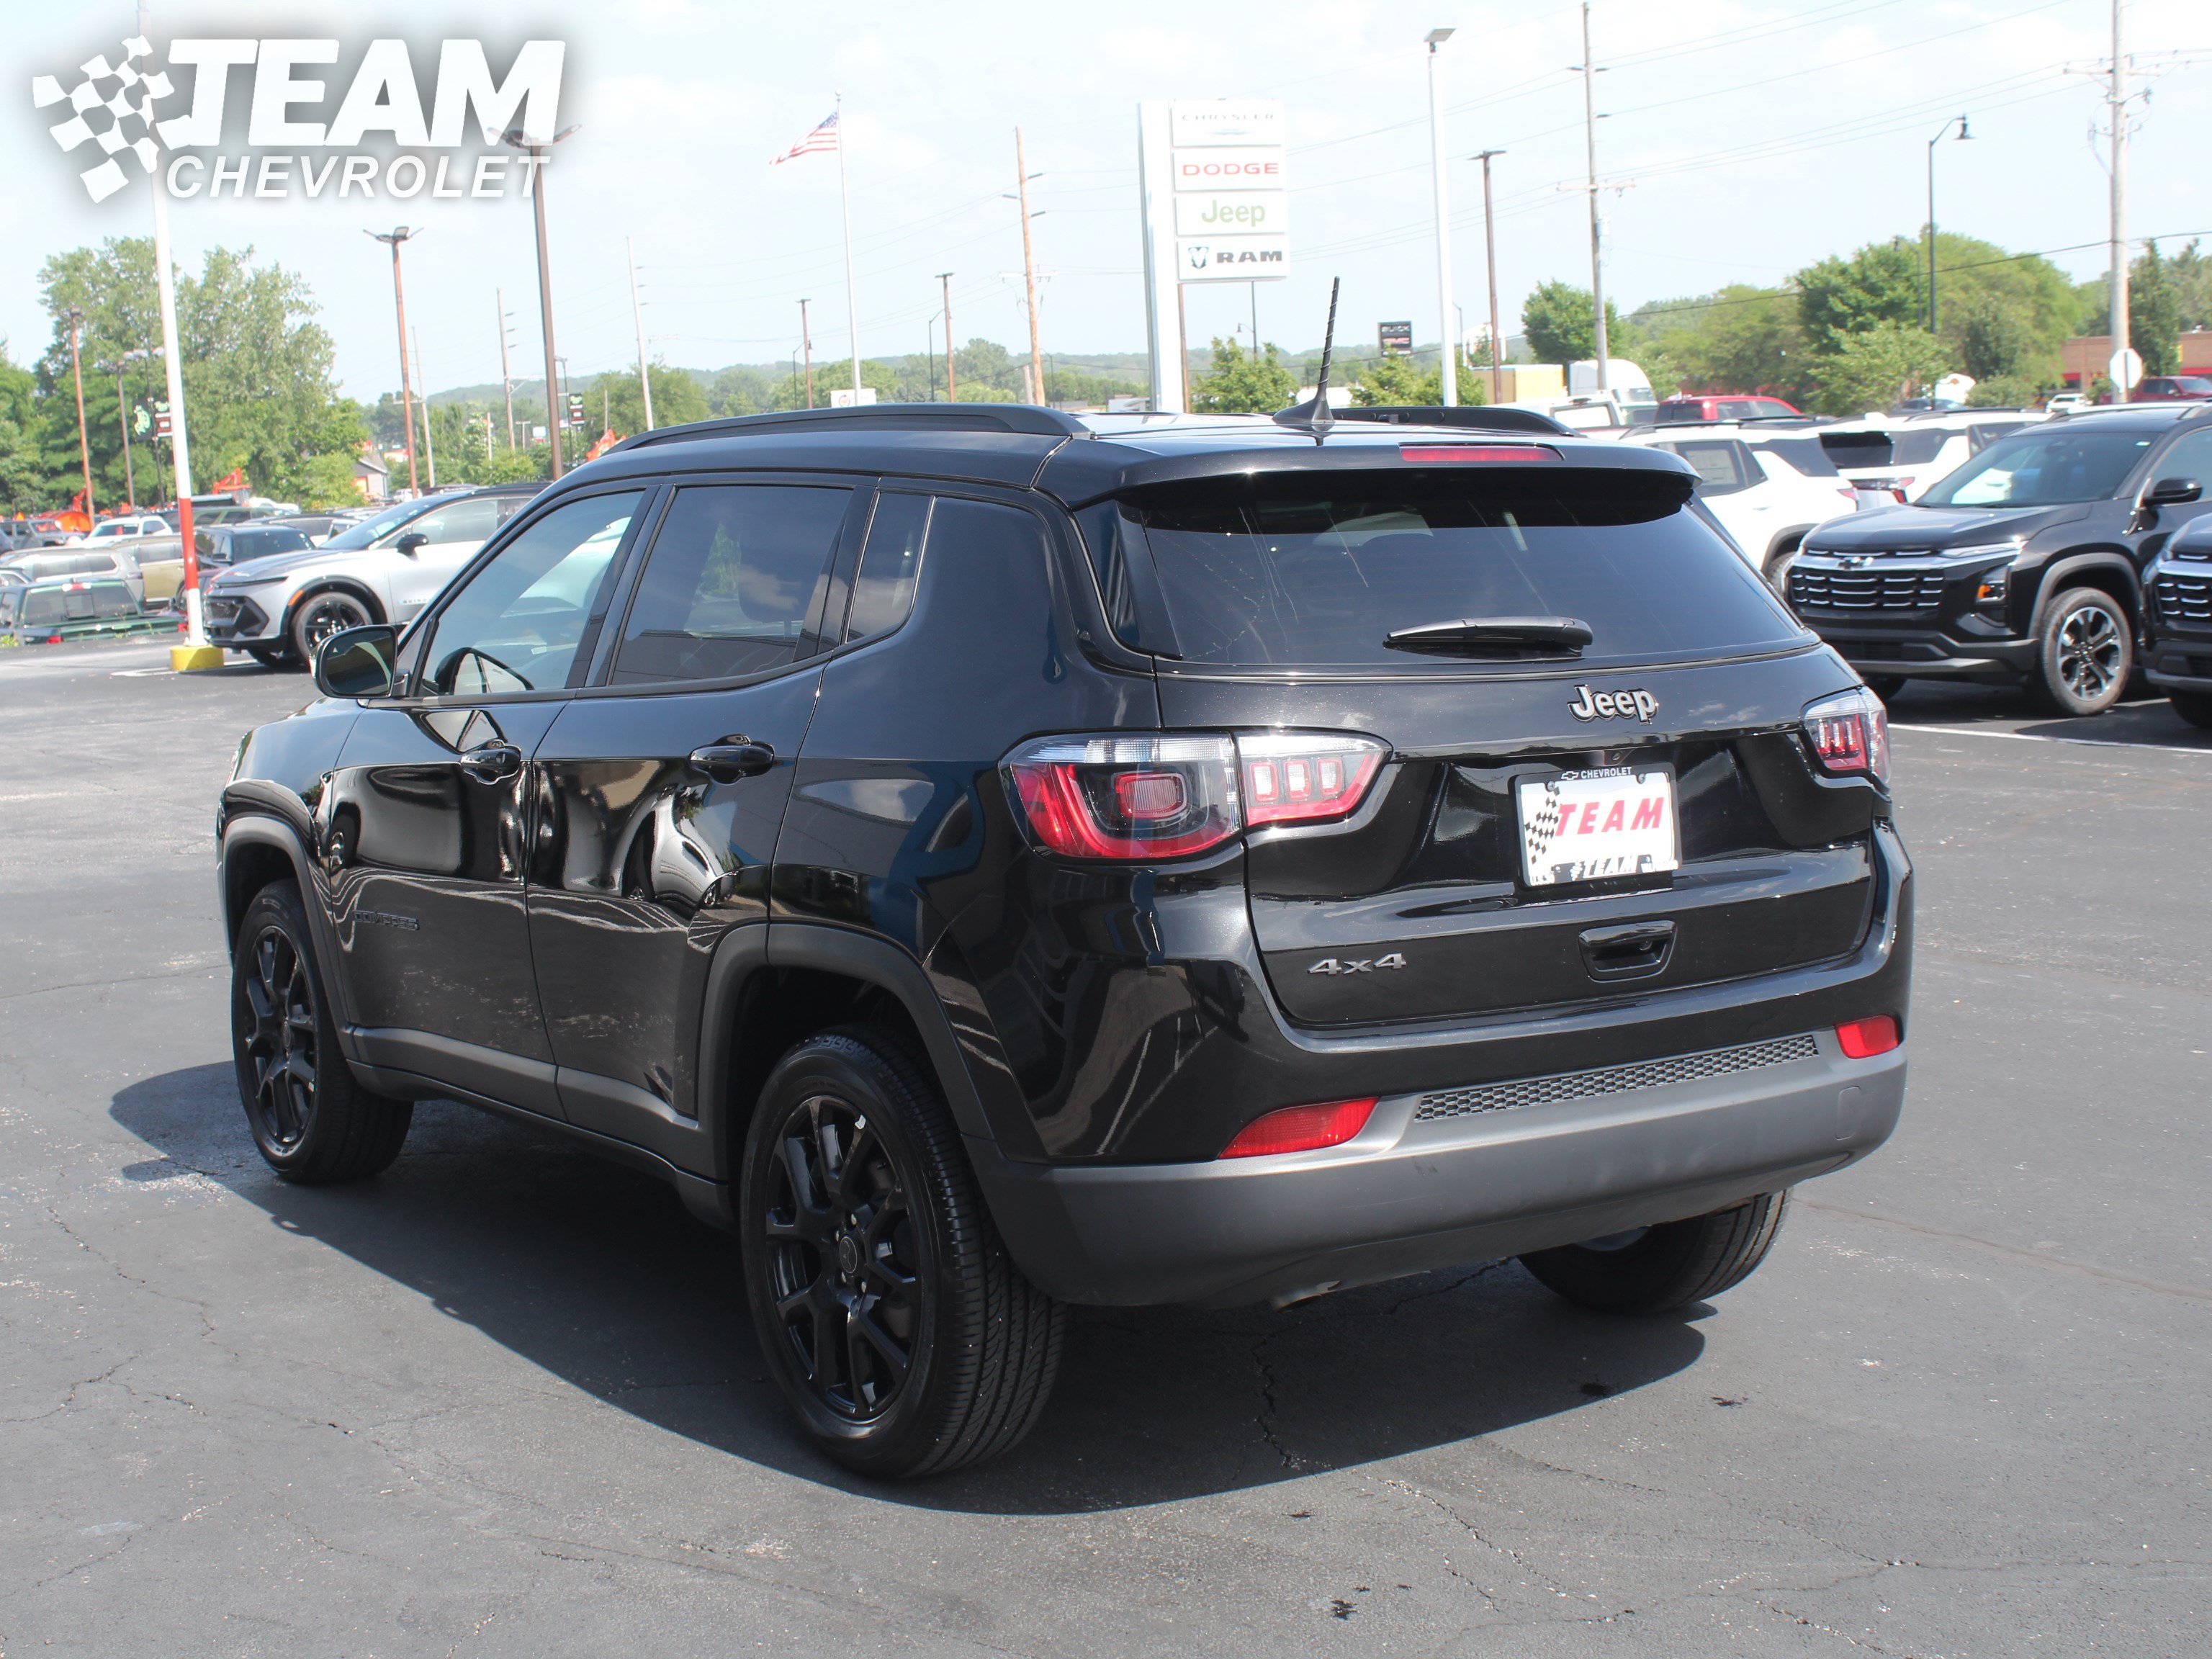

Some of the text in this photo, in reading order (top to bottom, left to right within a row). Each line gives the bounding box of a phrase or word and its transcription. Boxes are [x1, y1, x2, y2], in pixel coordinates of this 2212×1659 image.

[1183, 163, 1279, 176] DODGE
[1201, 199, 1266, 227] Jeep
[1216, 251, 1282, 264] RAM
[1568, 684, 1658, 725] Jeep
[1580, 766, 1632, 780] CHEVROLET
[1555, 797, 1665, 837] TEAM
